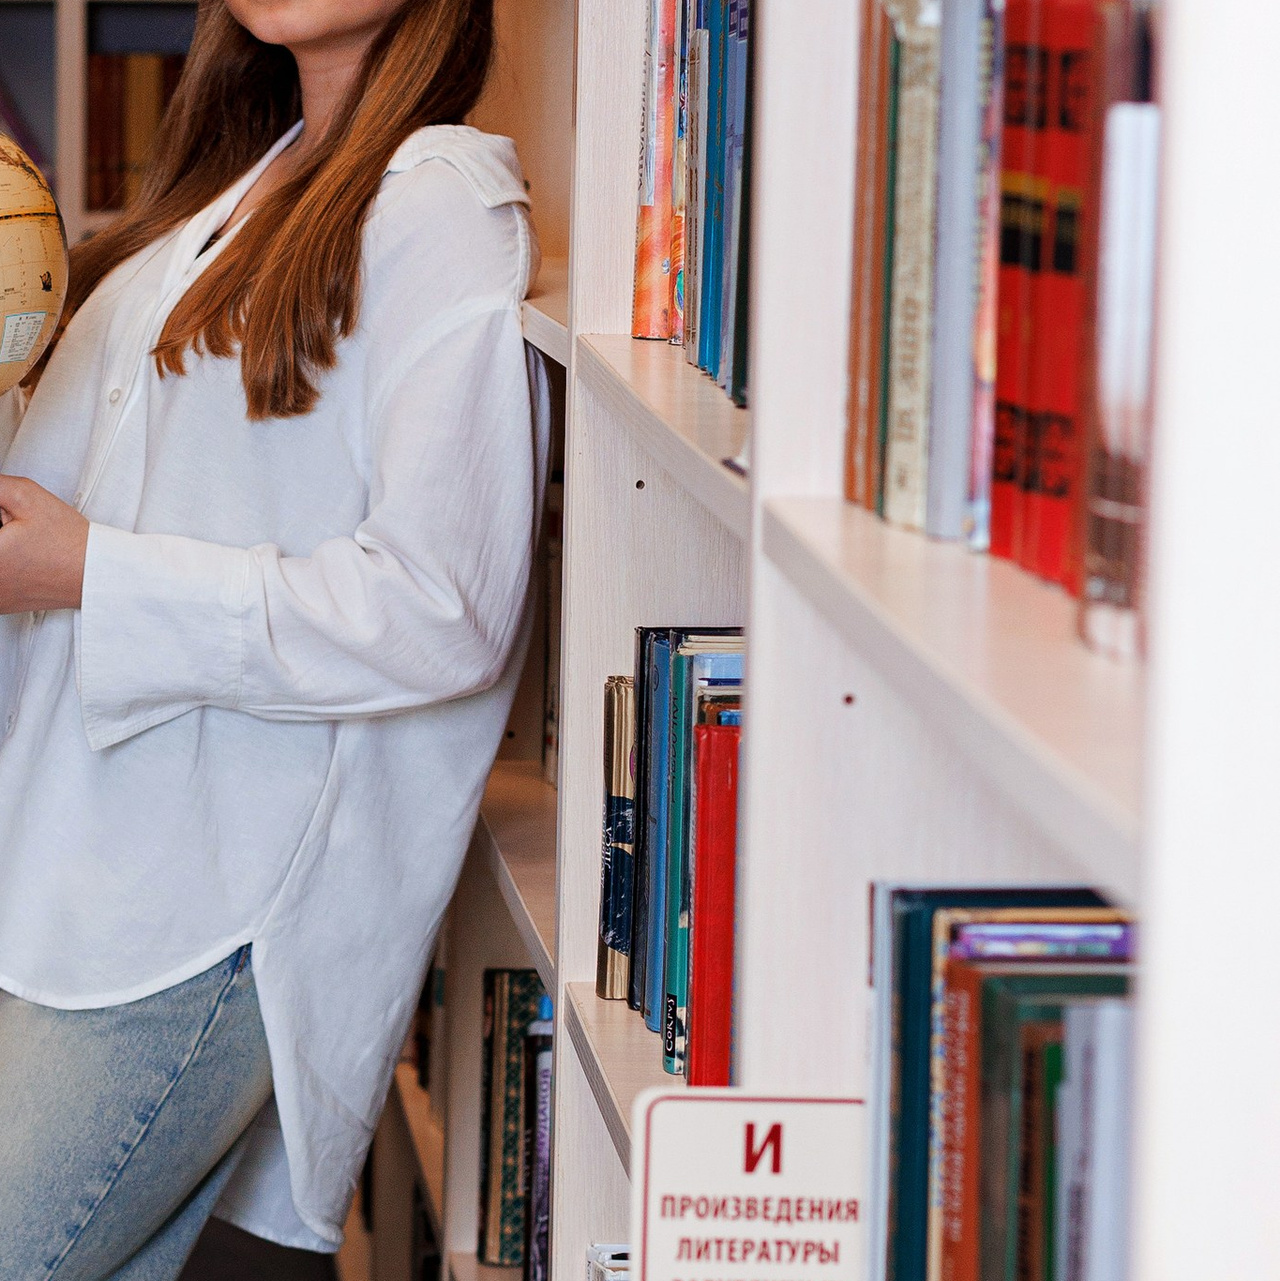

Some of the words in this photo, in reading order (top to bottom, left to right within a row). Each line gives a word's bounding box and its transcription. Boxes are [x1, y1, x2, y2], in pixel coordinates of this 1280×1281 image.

[743, 1122, 782, 1174] И
[660, 1194, 860, 1227] ПРОИЗВЕДЕНИЯ
[676, 1237, 840, 1264] ЛИТЕРАТУРЫ
